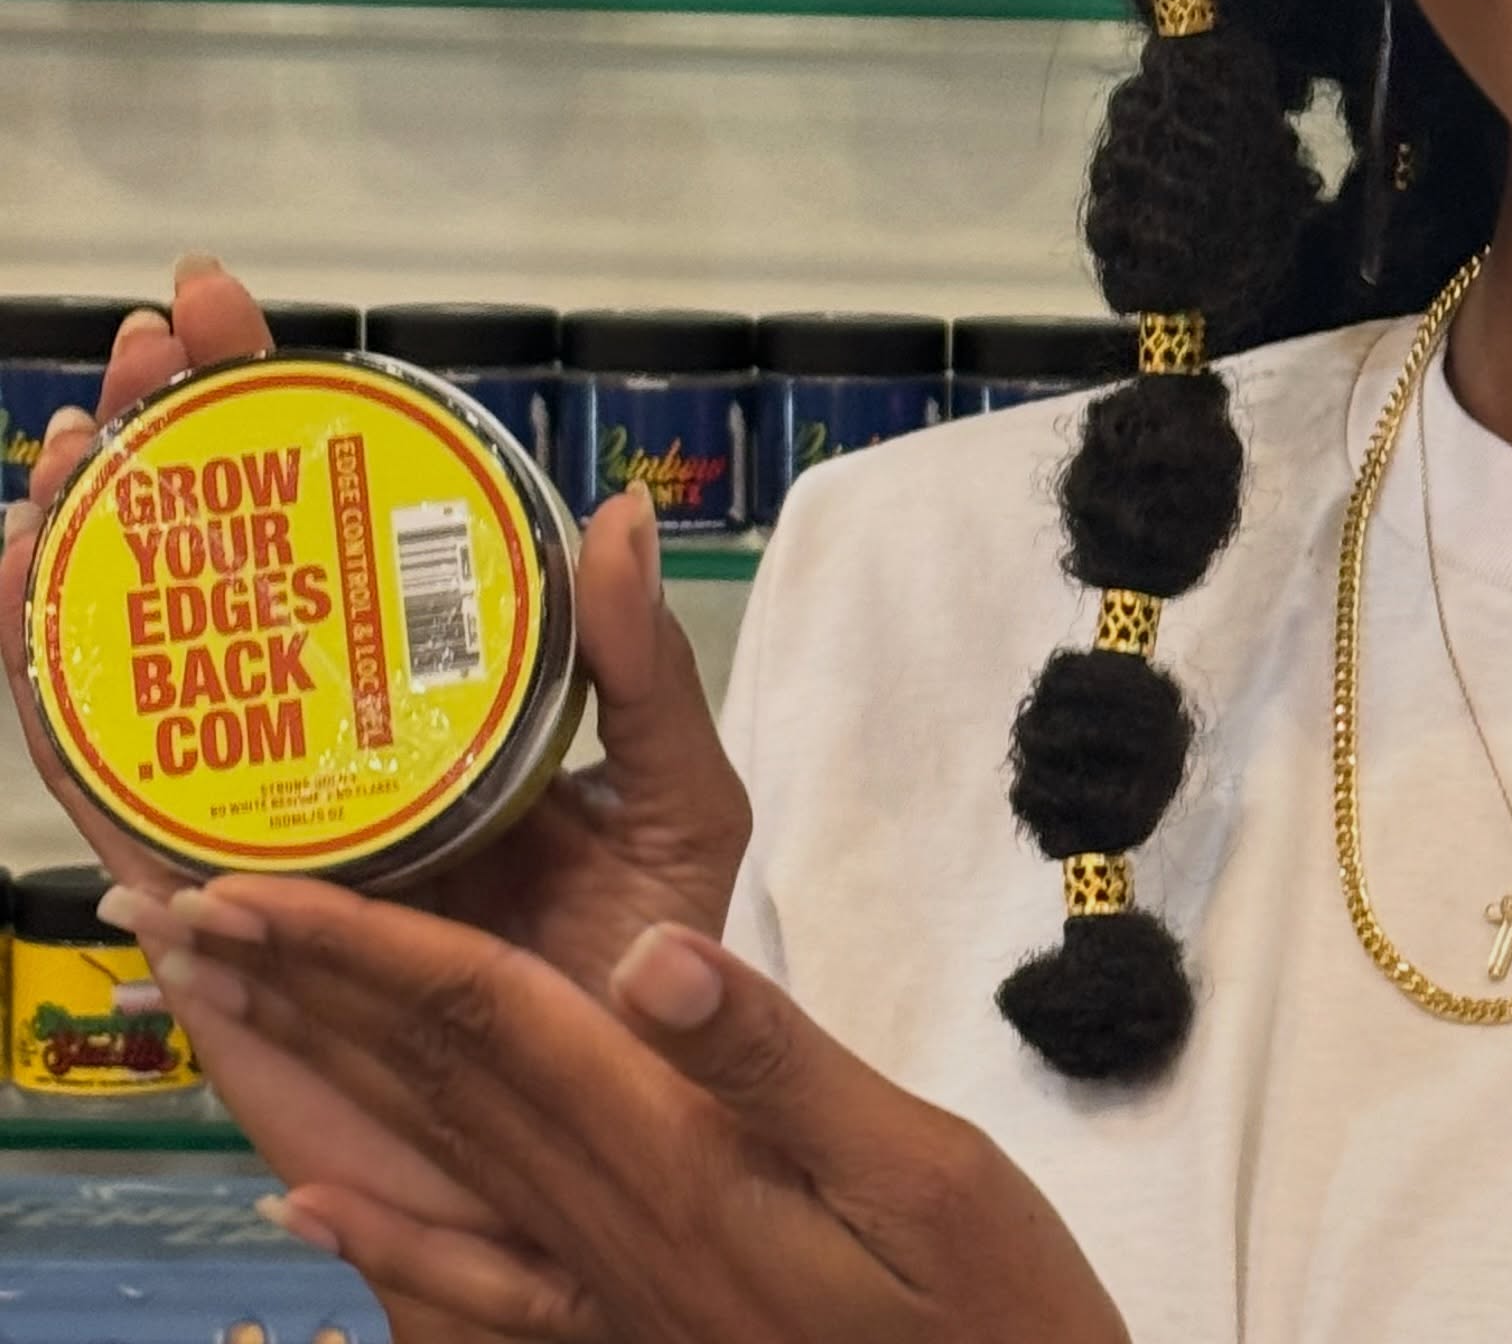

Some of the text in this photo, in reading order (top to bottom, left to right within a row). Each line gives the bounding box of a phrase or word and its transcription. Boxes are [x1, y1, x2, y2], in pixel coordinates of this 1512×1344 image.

[116, 447, 301, 526] GROW
[124, 512, 293, 586] YOUR
[340, 507, 373, 621] CONTROL
[127, 565, 332, 647] EDGES
[132, 630, 316, 716] BACK
[138, 699, 306, 781] .COM
